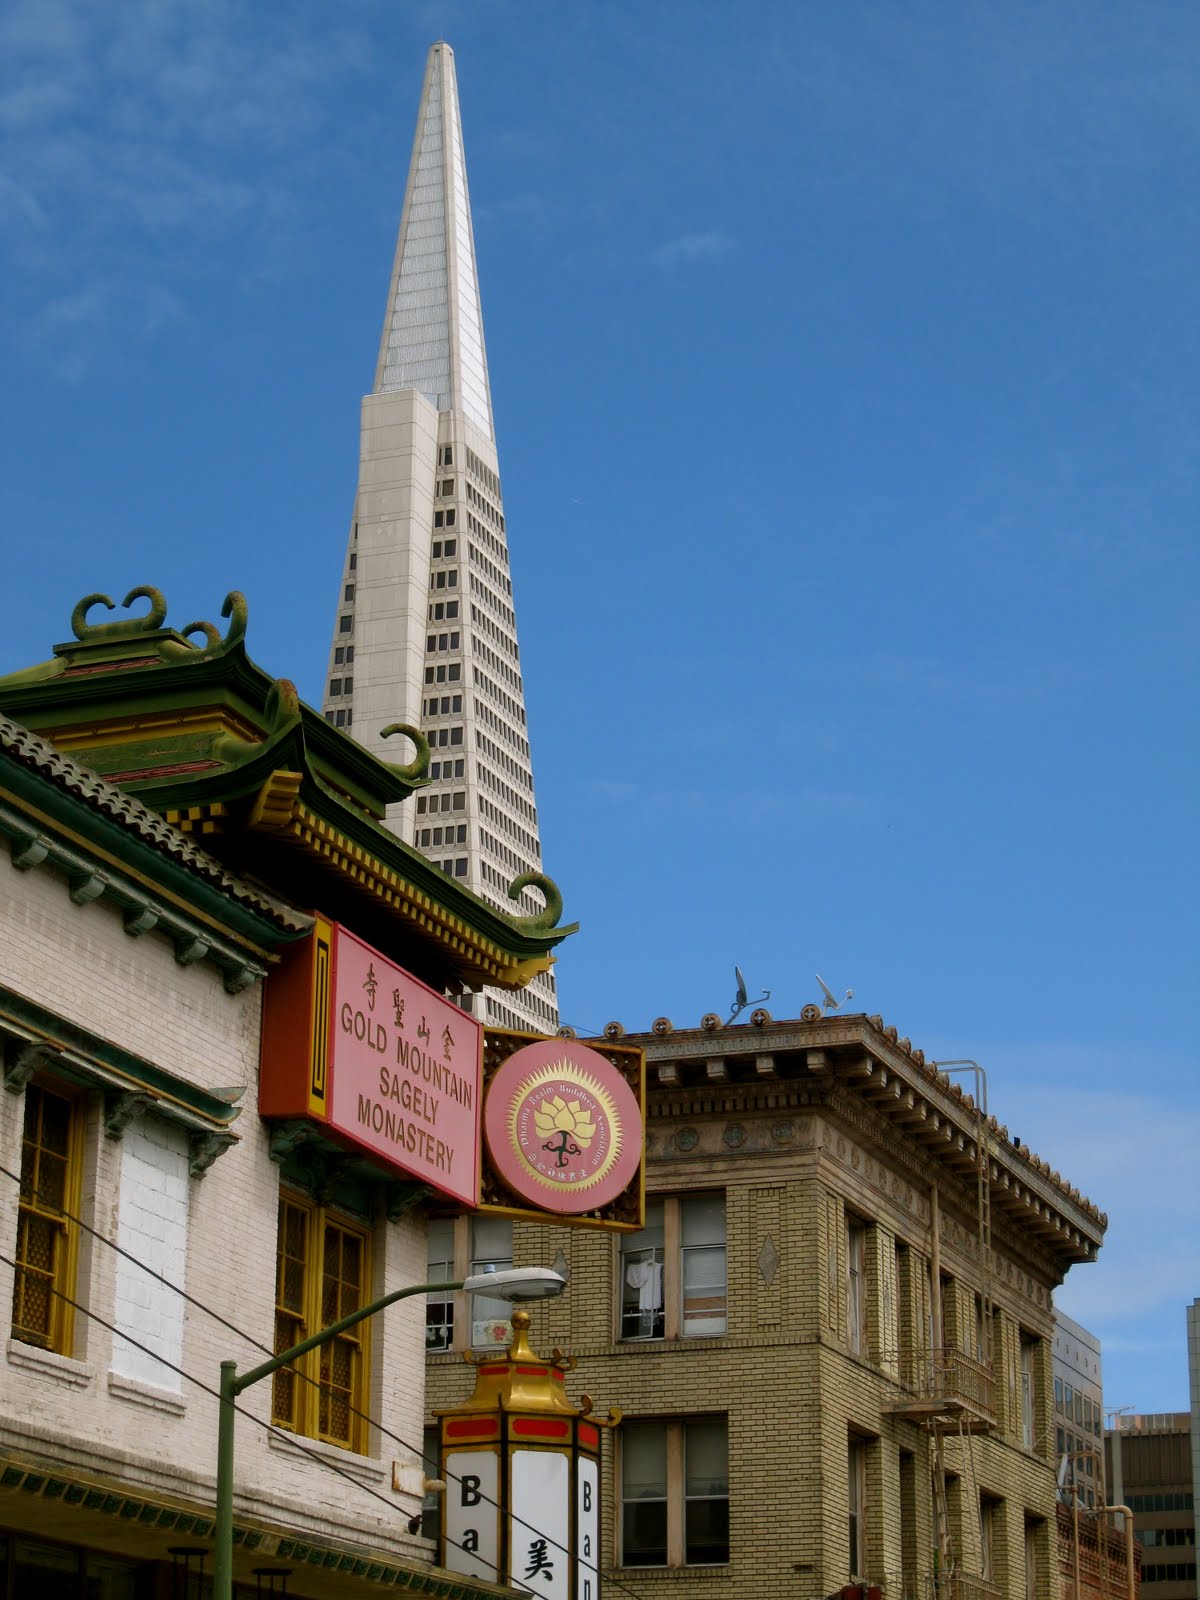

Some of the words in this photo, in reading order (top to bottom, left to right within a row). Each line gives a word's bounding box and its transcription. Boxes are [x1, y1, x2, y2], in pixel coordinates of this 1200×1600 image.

[341, 1002, 388, 1054] GOLD
[397, 1036, 472, 1111] MOUNTAIN
[379, 1066, 439, 1126] SAGELY
[357, 1093, 454, 1174] MONASTERY
[521, 1107, 531, 1146] Dharma
[528, 1085, 555, 1105] Realm
[560, 1084, 597, 1110] Buddhist
[591, 1113, 608, 1165] Association
[461, 1475, 482, 1578] Ba
[524, 1538, 555, 1582] 美
